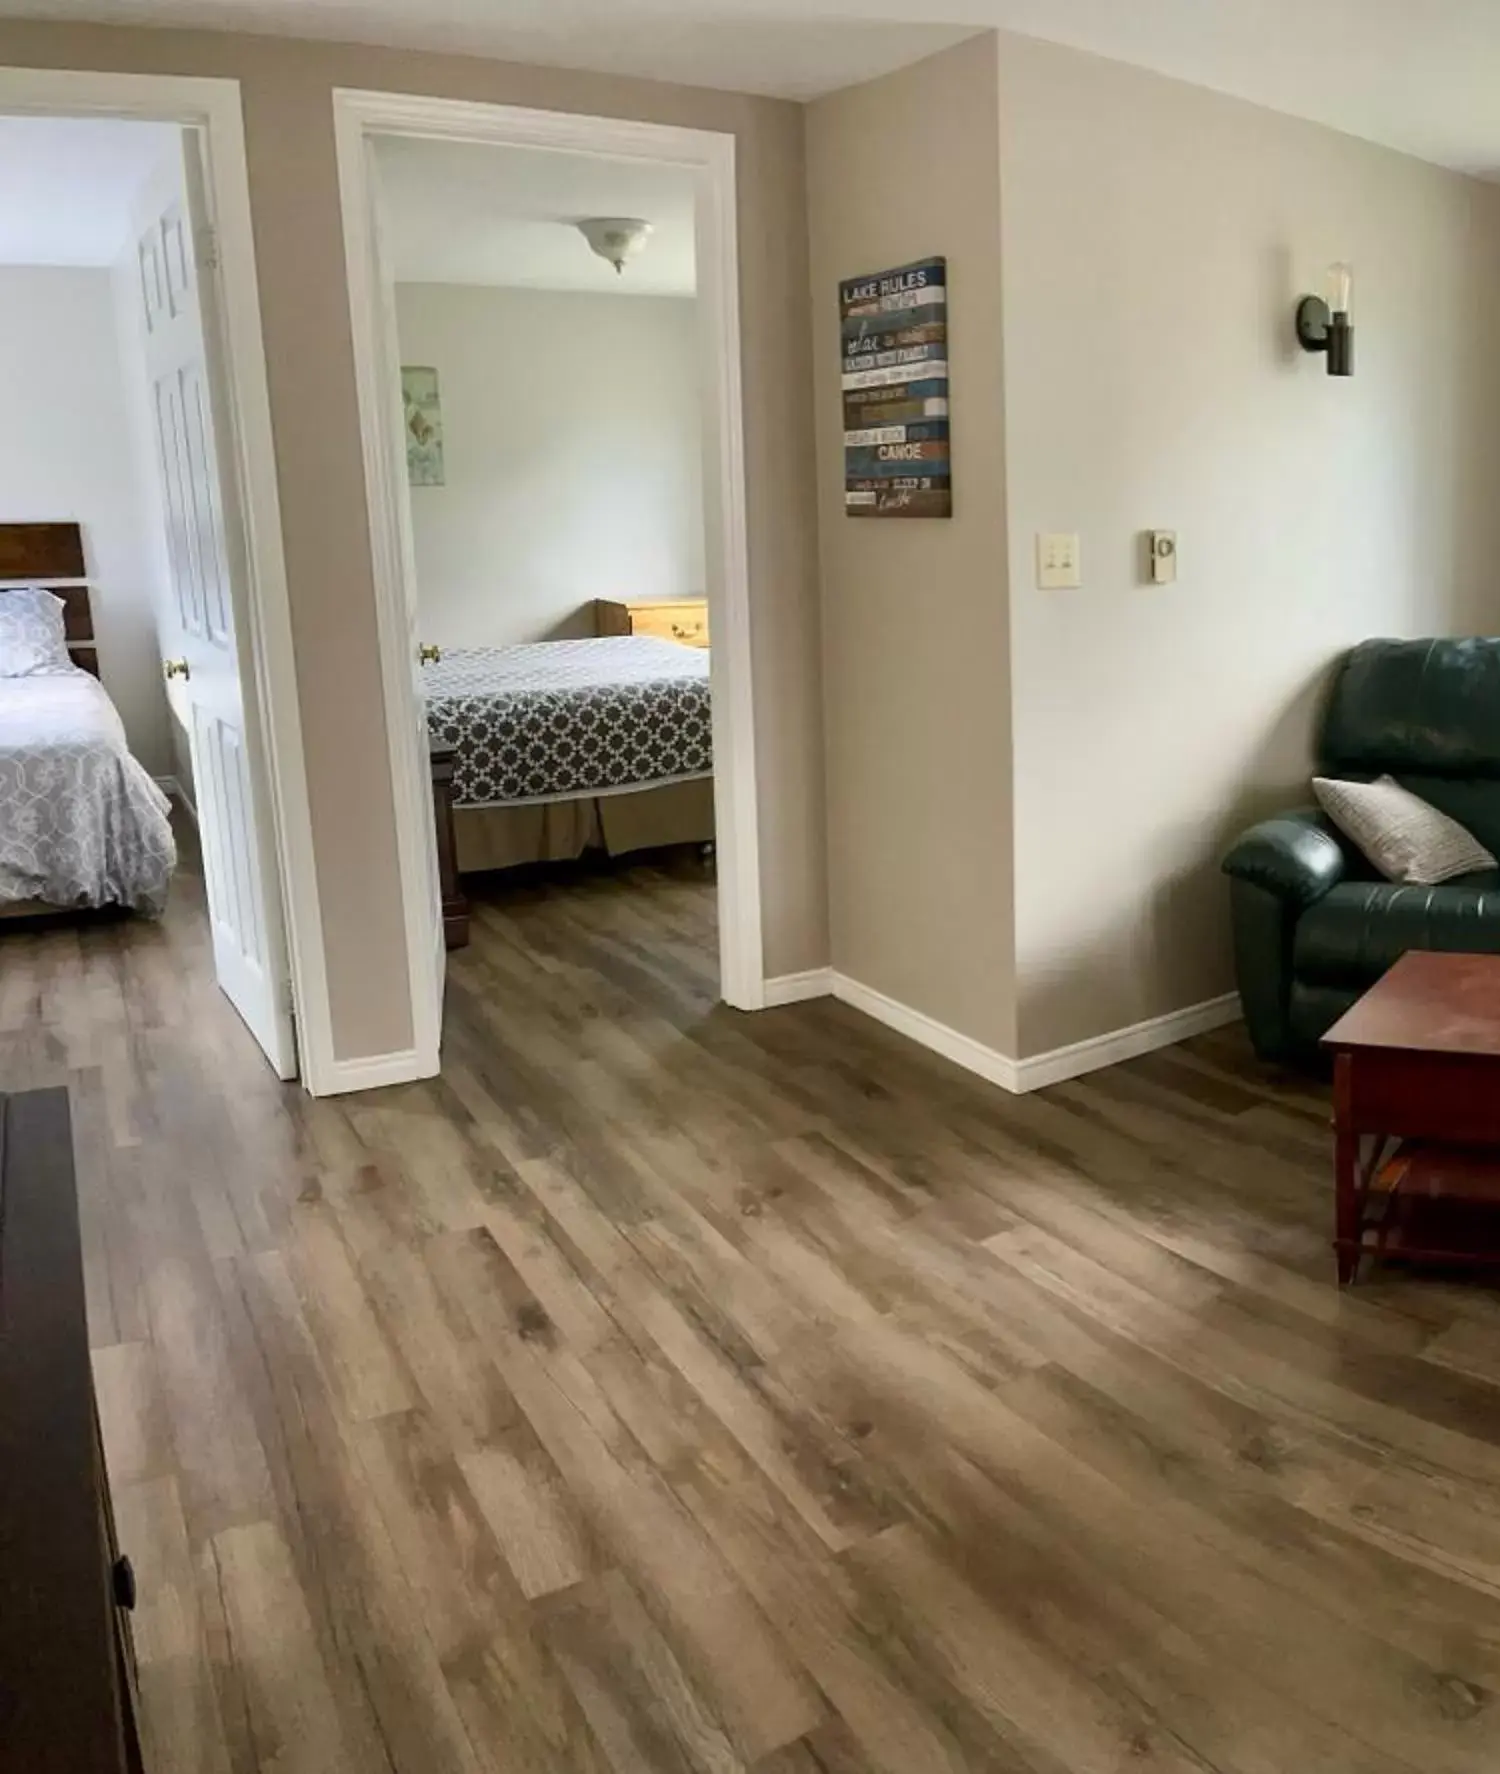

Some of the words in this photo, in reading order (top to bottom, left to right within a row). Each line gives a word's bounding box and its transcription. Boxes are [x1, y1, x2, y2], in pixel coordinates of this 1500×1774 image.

[843, 283, 877, 304] LAKE
[880, 271, 927, 296] RULES
[878, 443, 923, 460] CANOE
